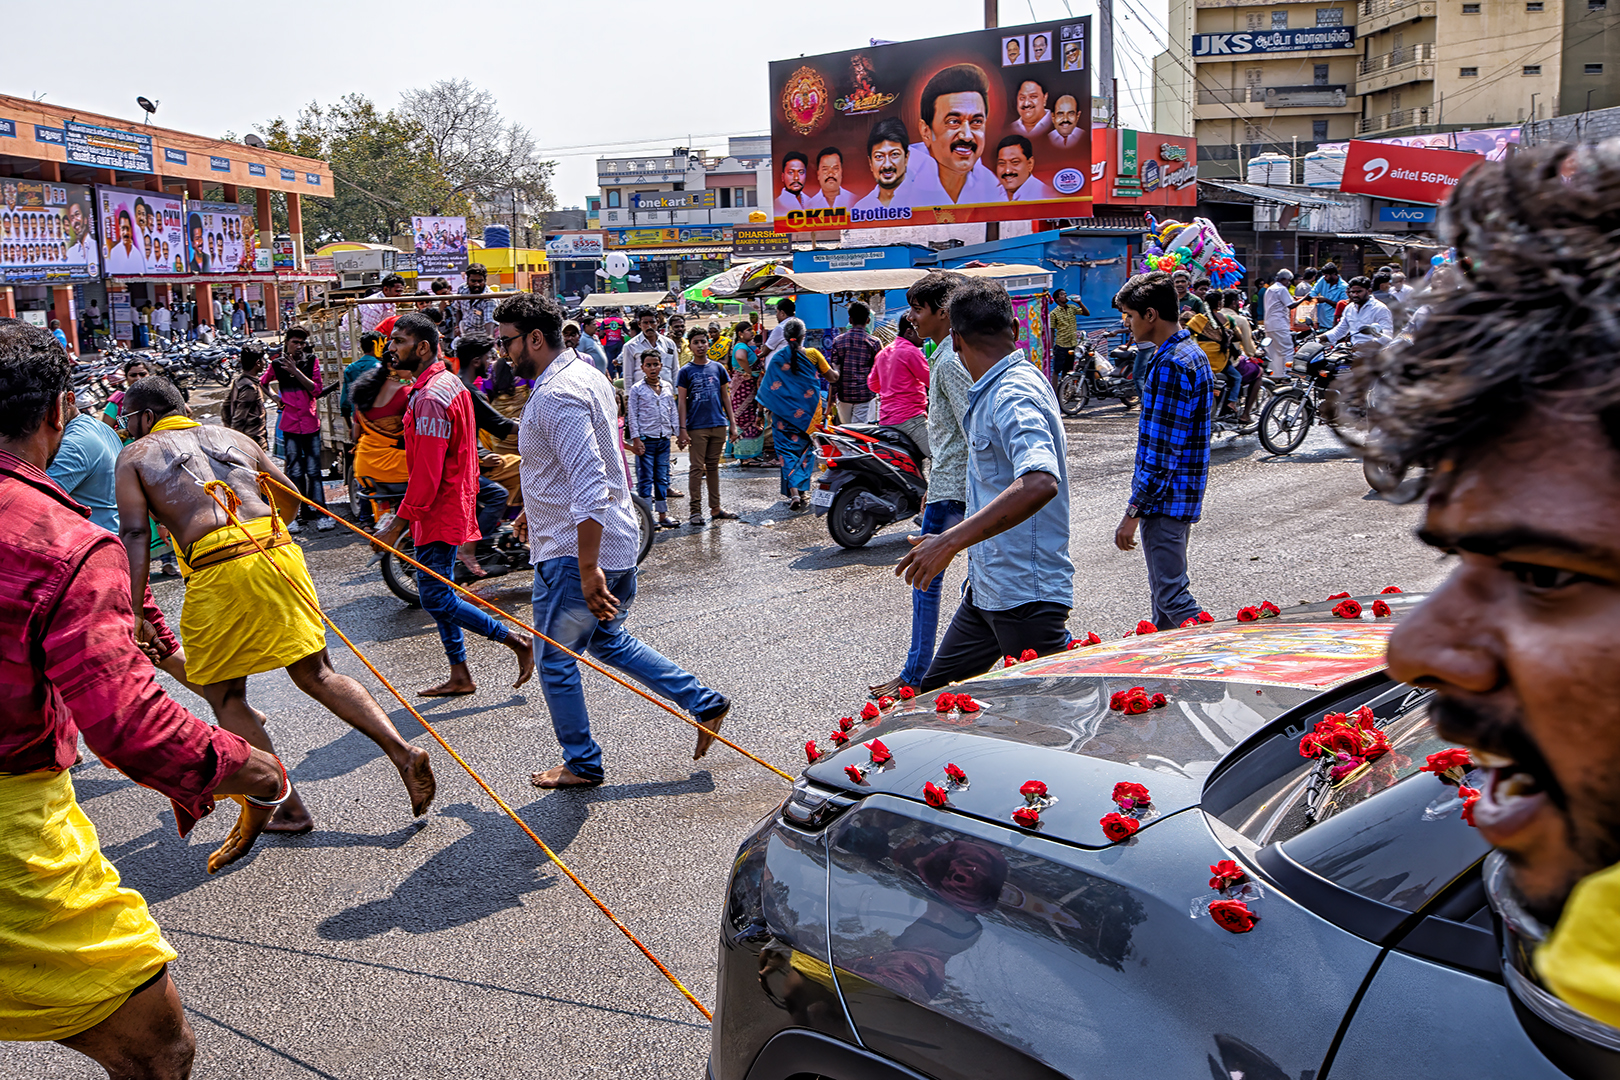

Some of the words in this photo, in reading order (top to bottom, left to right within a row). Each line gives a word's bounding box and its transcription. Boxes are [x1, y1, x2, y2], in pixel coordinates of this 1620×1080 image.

[1196, 34, 1253, 55] JKS
[1255, 32, 1291, 49] ஆட்டோ
[1295, 29, 1350, 45] மொபைல்ஸ்
[1390, 168, 1419, 181] airtel
[630, 194, 686, 208] fonekart
[787, 207, 847, 228] CKM
[851, 206, 912, 222] Brothers
[1391, 209, 1424, 219] vivo
